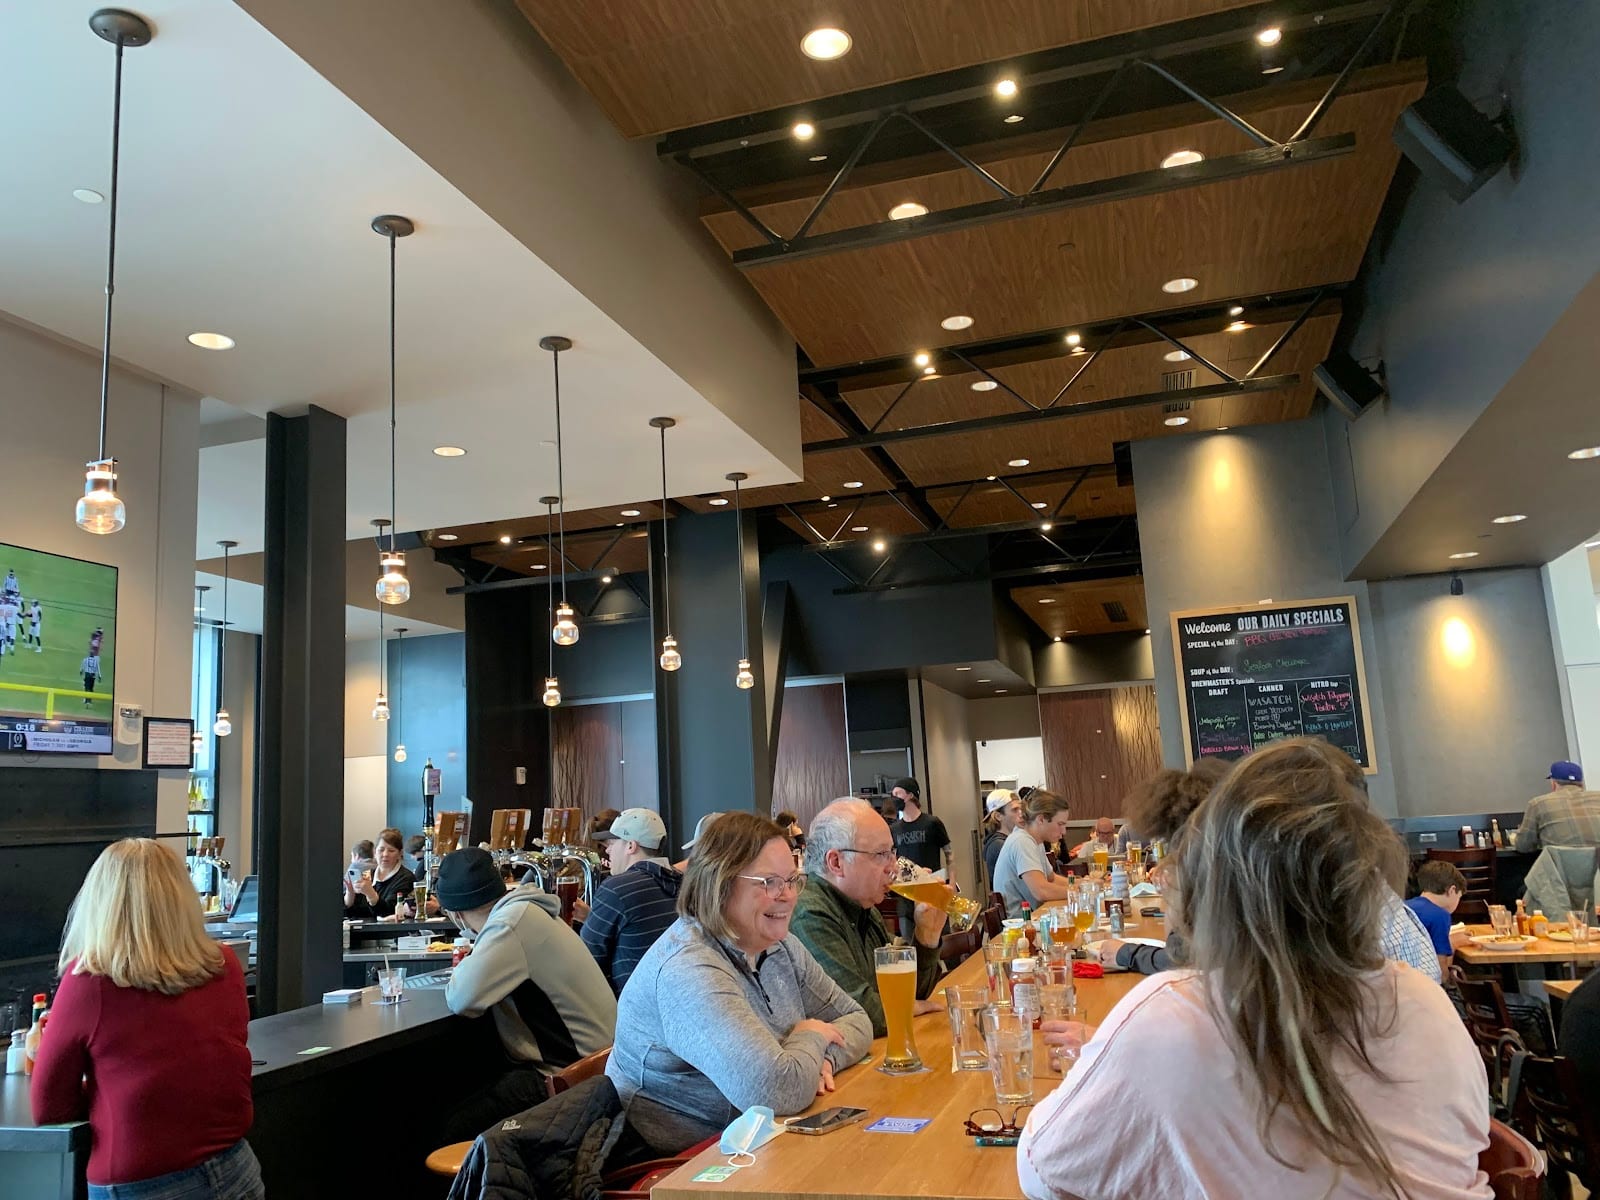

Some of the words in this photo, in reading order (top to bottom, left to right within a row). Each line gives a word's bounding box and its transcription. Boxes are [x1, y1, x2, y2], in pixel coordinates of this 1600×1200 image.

[1237, 616, 1259, 631] OUR
[1262, 612, 1290, 629] DAILY
[1293, 608, 1344, 626] SPECIALS
[1184, 621, 1232, 635] Welcome
[1187, 641, 1210, 649] SPECIAL
[1190, 668, 1205, 676] SOUP
[1258, 684, 1284, 693] CANNED
[1310, 680, 1330, 689] NITRO
[1208, 688, 1229, 697] DRAFT
[1247, 694, 1293, 707] WASATCH
